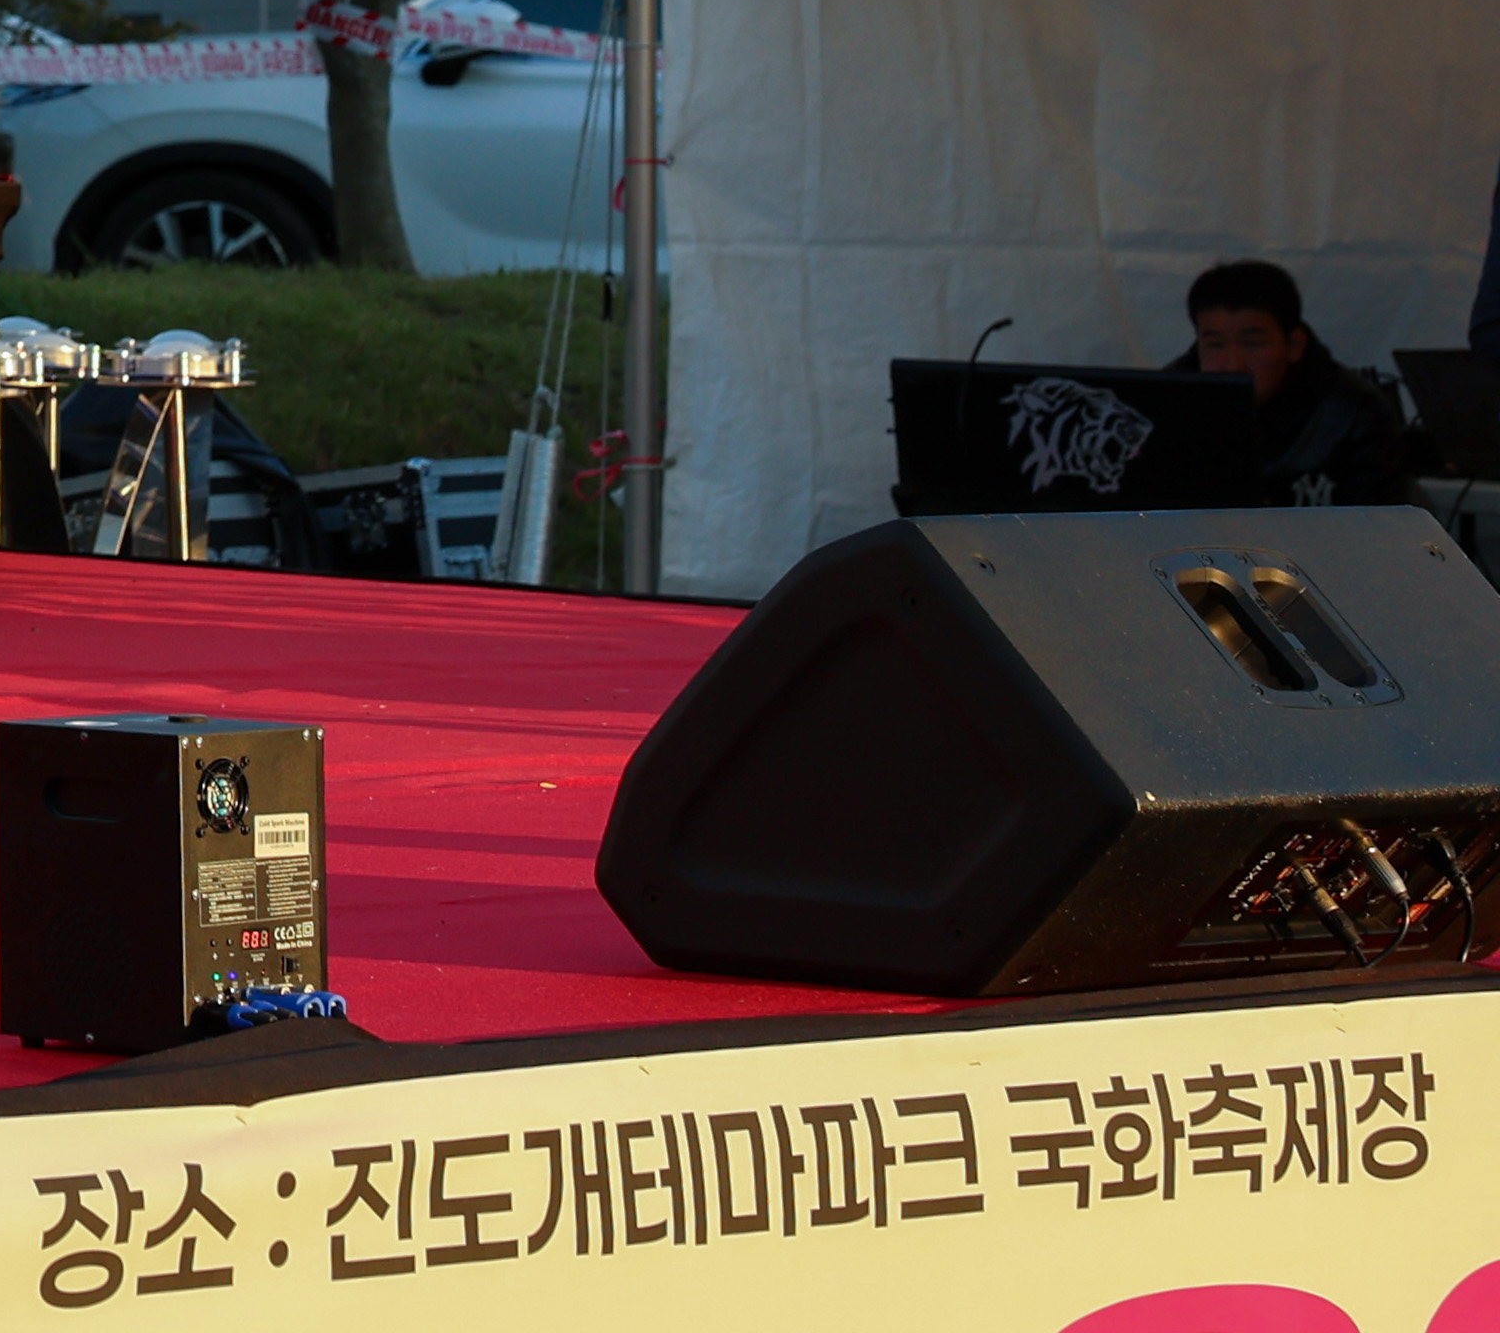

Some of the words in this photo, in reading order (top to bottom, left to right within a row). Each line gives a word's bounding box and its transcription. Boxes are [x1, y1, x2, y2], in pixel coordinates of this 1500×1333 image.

[33, 1163, 237, 1309] 장소
[326, 1093, 985, 1281] 진도개테마파크
[1004, 1052, 1435, 1209] 국화축제장
